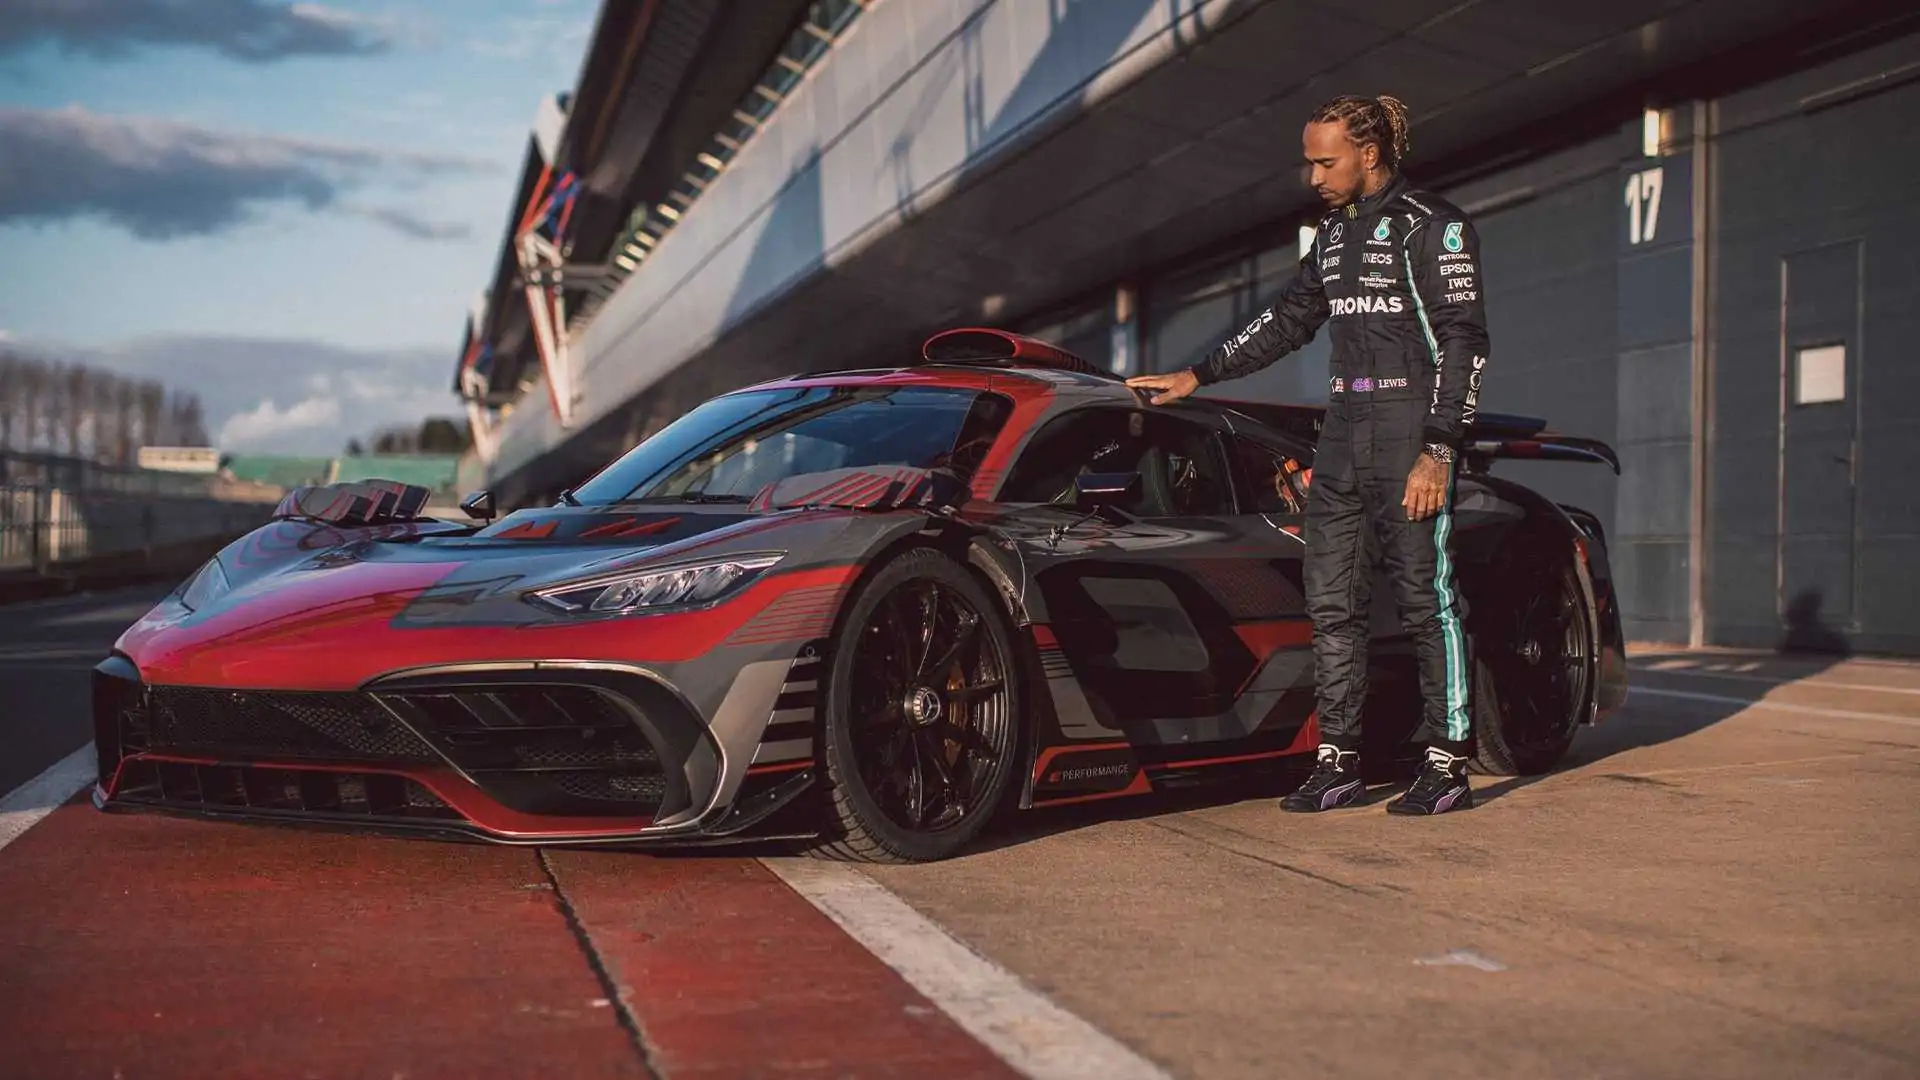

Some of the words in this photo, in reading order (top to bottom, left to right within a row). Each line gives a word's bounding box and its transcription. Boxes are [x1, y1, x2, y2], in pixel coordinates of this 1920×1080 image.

[1624, 167, 1664, 244] 17
[1362, 253, 1393, 264] INEOS
[1440, 263, 1474, 276] EPSON
[1448, 277, 1473, 289] IWC
[1328, 296, 1404, 317] TRONAS
[1378, 378, 1407, 389] LEWIS
[1461, 355, 1486, 425] INEOS
[1062, 763, 1129, 781] PERFORMANCE
